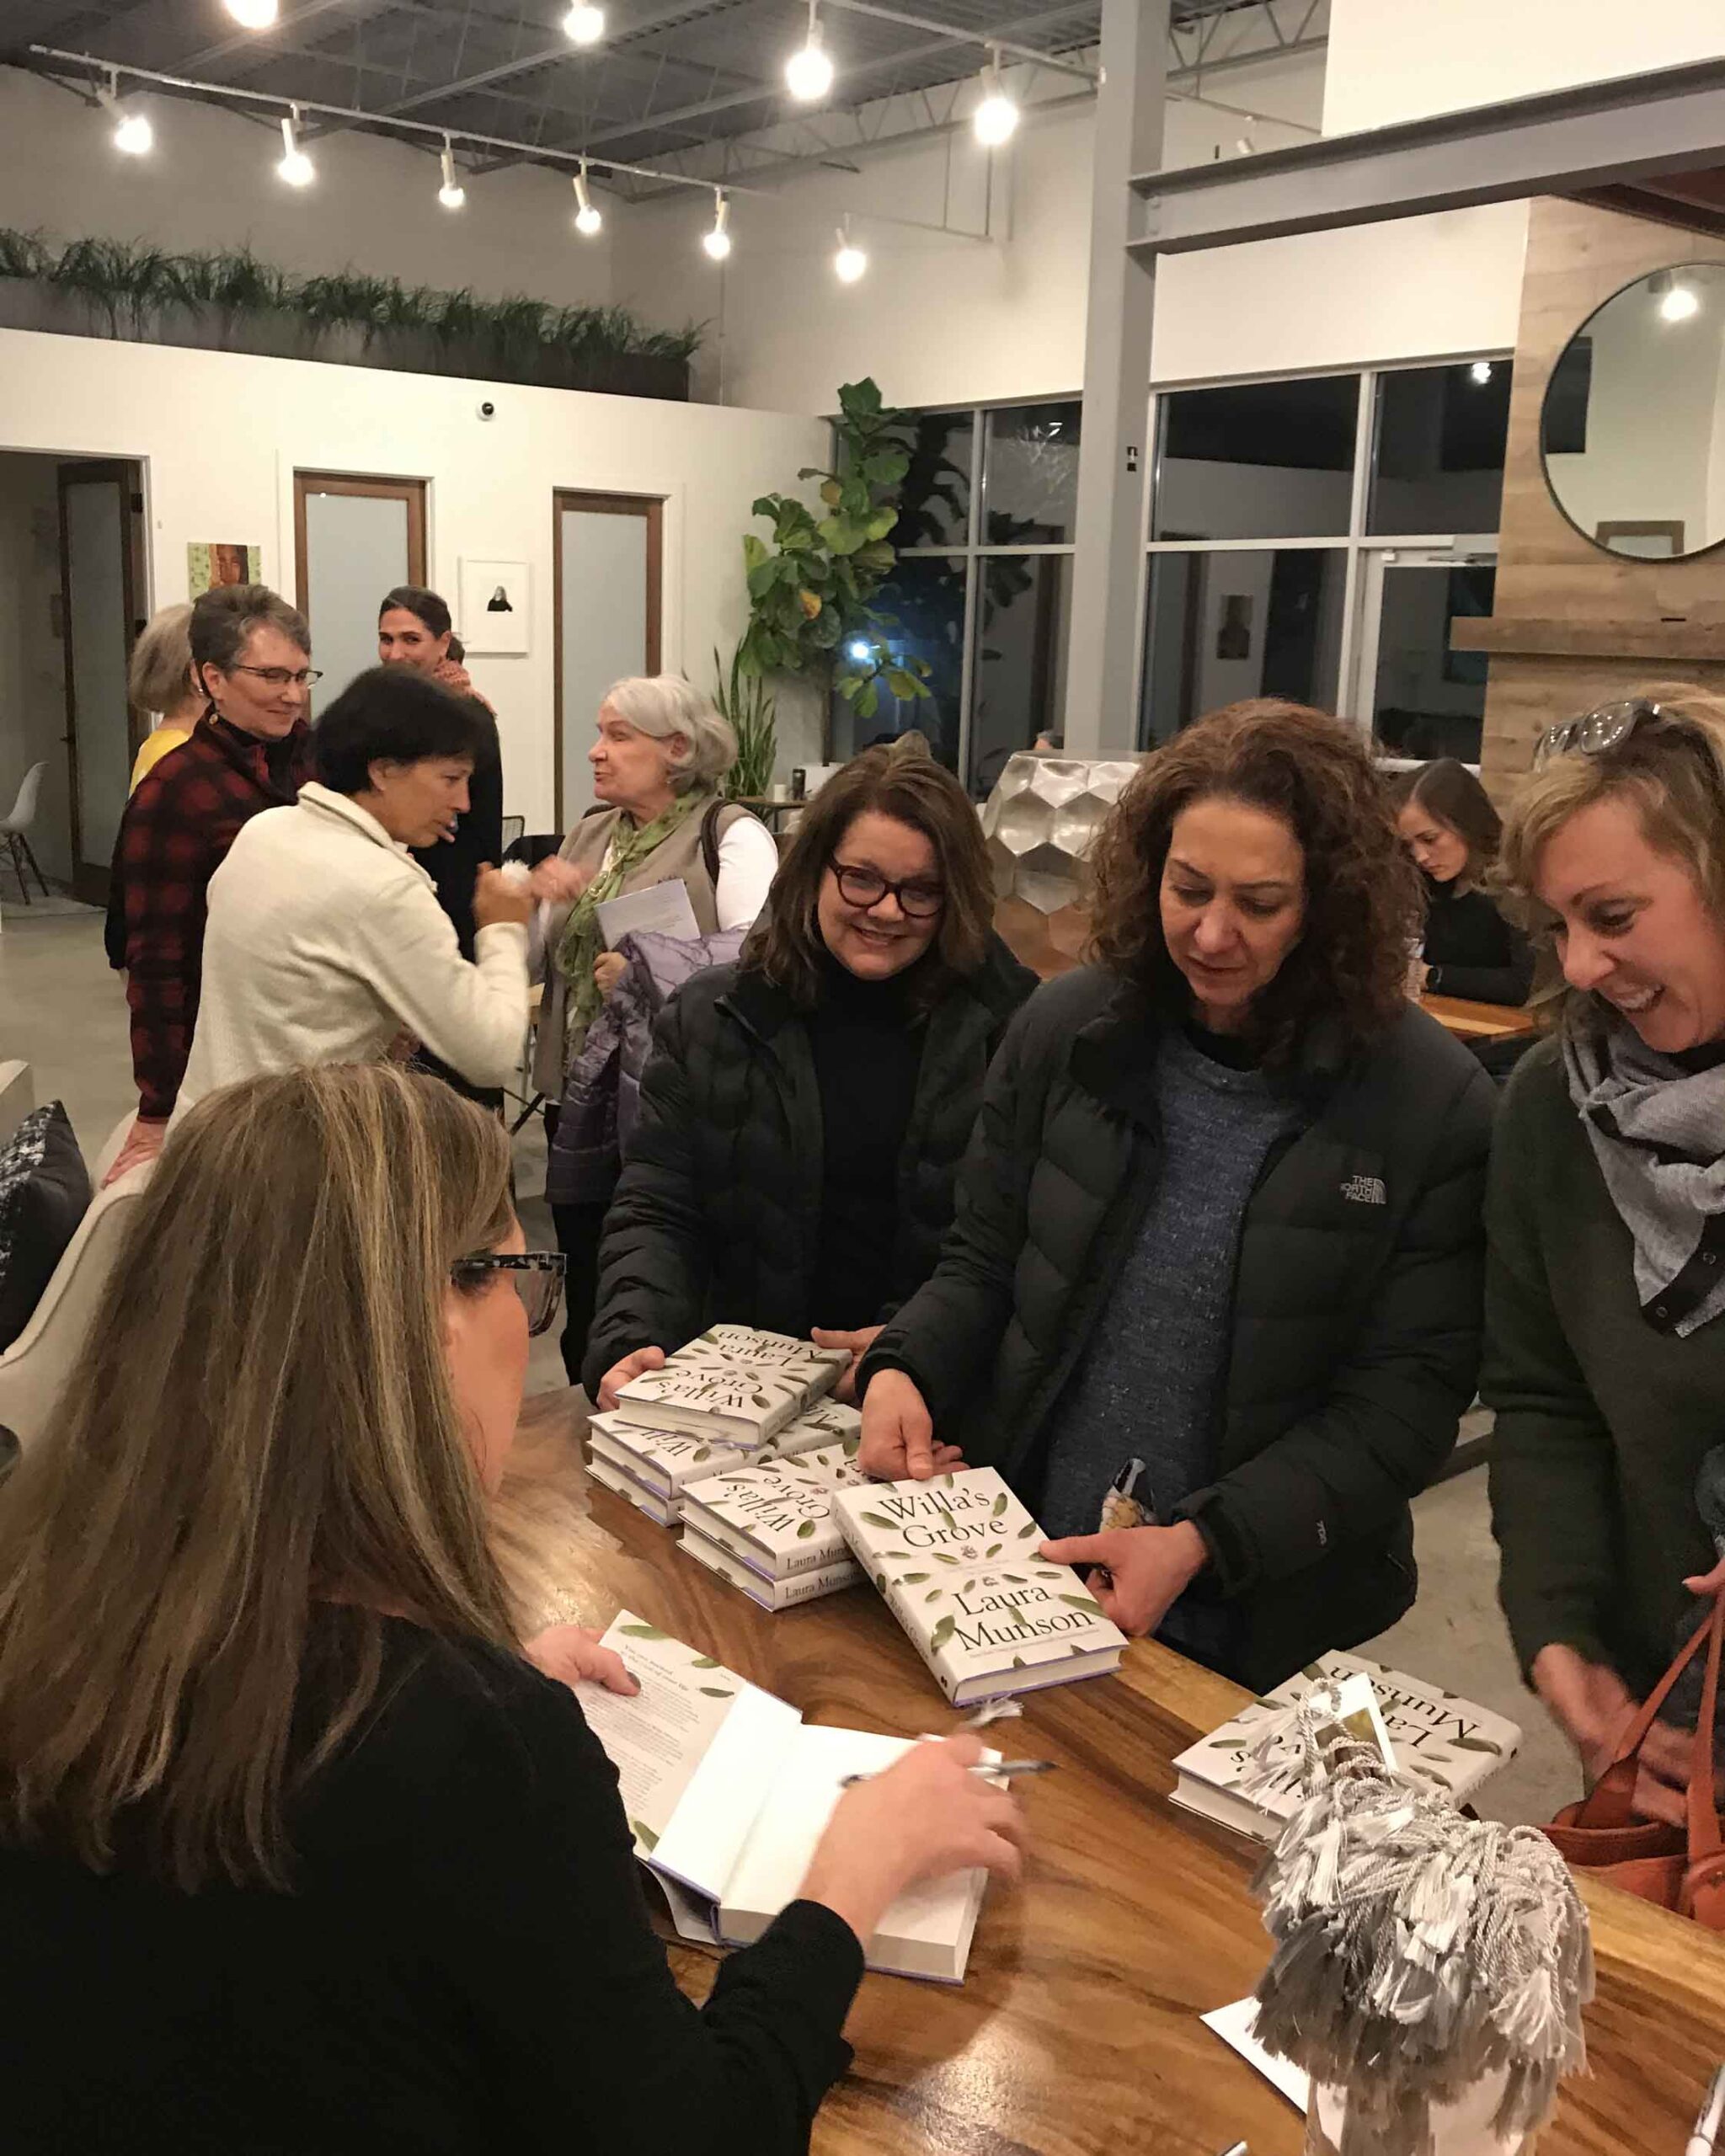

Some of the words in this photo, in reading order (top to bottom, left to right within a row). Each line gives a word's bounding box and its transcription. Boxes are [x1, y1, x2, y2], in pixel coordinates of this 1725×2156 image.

[1353, 1175, 1374, 1186] THE
[1345, 1192, 1371, 1203] FACE
[718, 1331, 823, 1360] Munson
[718, 1344, 793, 1367] Laura
[656, 1380, 744, 1409] Willa's
[676, 1369, 764, 1395] Grove
[640, 1430, 692, 1457] Will
[724, 1483, 796, 1532] Willa's
[763, 1476, 830, 1519] Grove
[879, 1486, 991, 1521] Willa's
[902, 1518, 1009, 1548] Grove
[786, 1552, 817, 1572] Laura
[784, 1580, 815, 1600] Laura
[951, 1586, 1053, 1616] Laura
[953, 1610, 1097, 1652] Munson
[1330, 1666, 1482, 1739] Munsn
